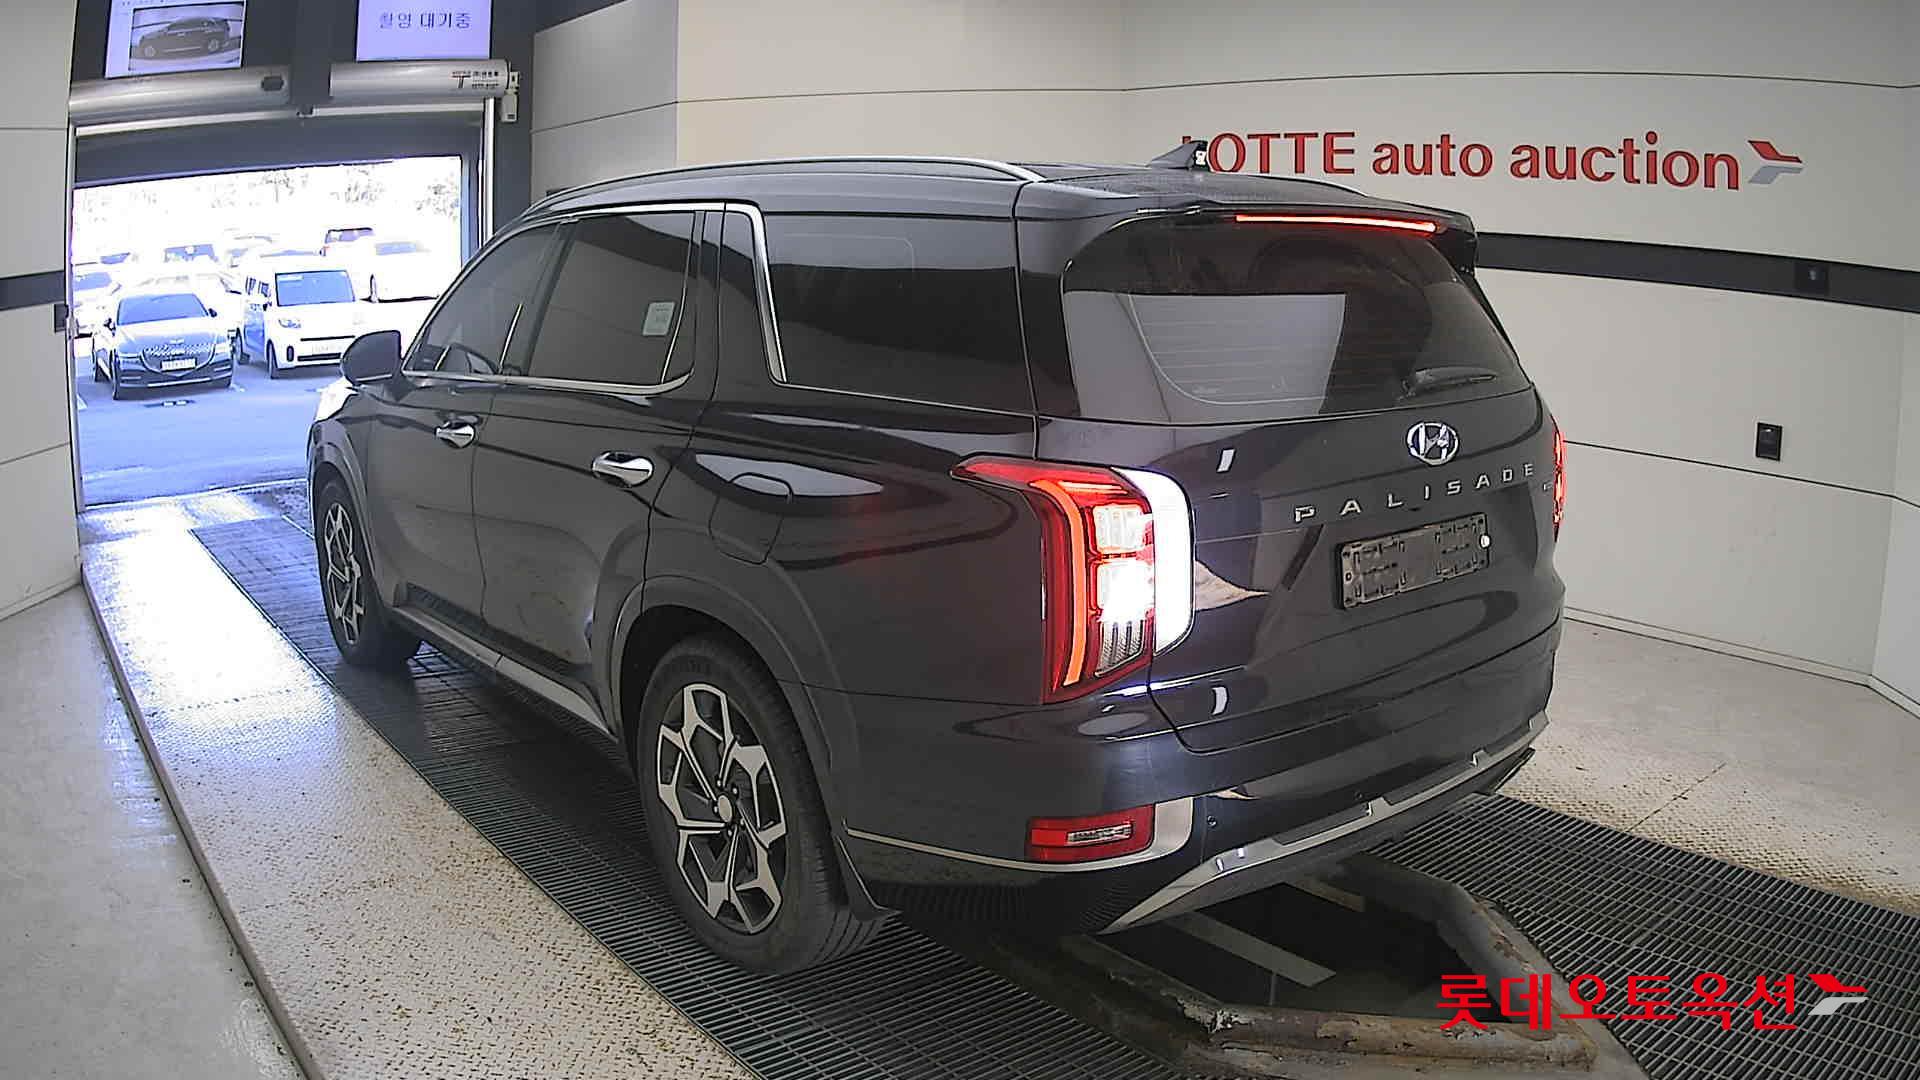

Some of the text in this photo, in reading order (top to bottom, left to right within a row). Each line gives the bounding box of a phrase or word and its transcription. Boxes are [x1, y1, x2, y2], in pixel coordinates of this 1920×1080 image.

[420, 12, 472, 29] 대기중
[1182, 130, 1740, 190] OTTE auto auction
[1294, 463, 1534, 522] PALISADE
